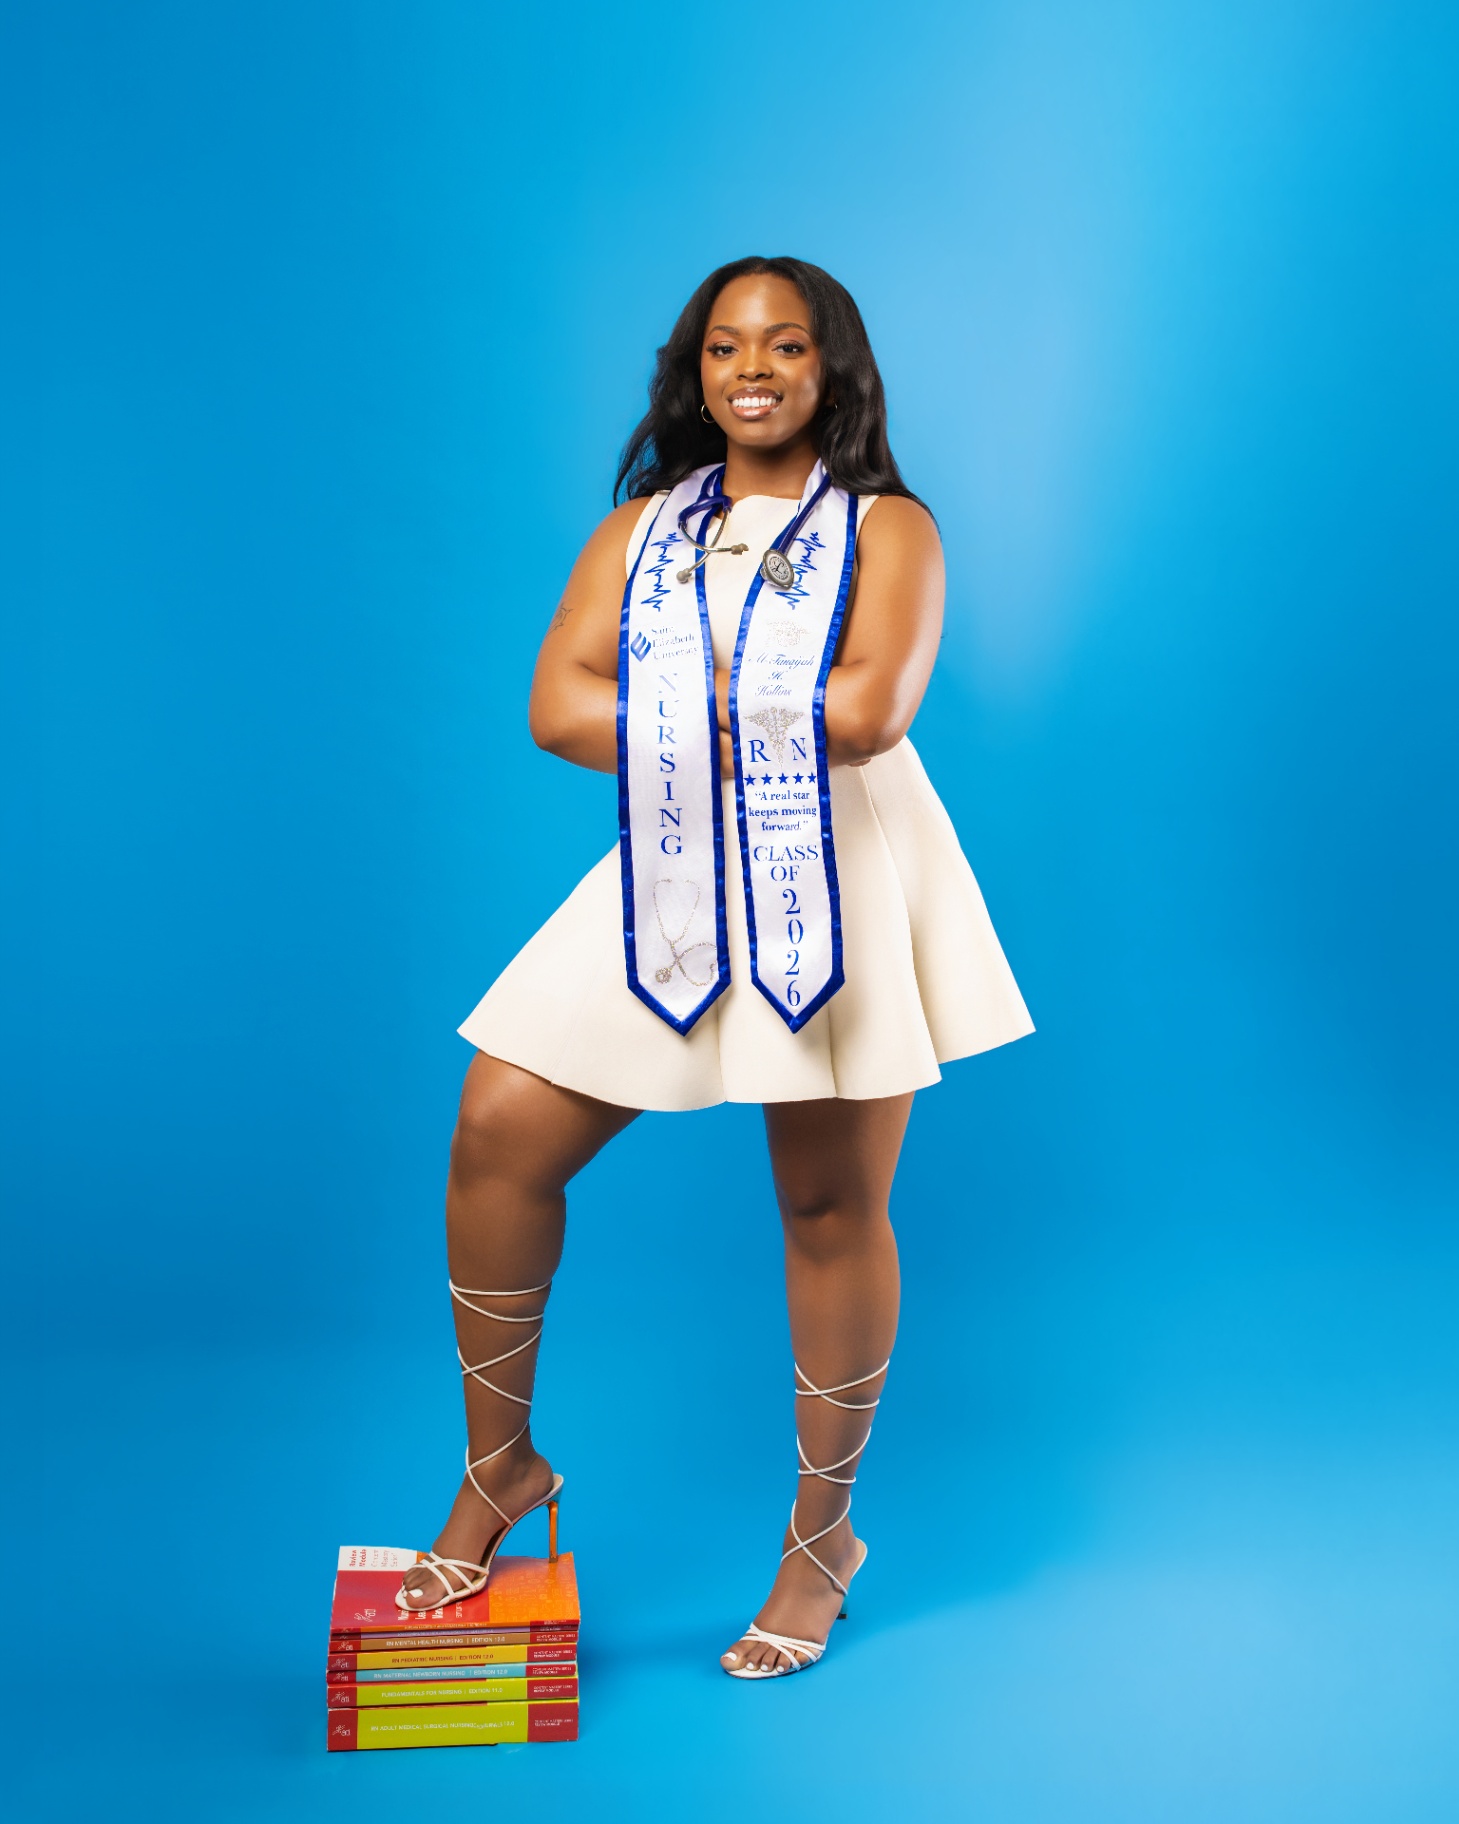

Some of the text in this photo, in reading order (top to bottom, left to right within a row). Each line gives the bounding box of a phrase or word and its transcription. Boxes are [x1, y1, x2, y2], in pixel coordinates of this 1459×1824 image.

[656, 673, 683, 855] NURSING
[770, 789, 790, 801] real
[792, 791, 811, 800] star
[748, 805, 817, 819] keeps moving
[753, 844, 819, 862] CLASS
[770, 864, 800, 882] OF
[782, 888, 804, 1007] 2026
[381, 1690, 425, 1698] FUNDAMENTALS
